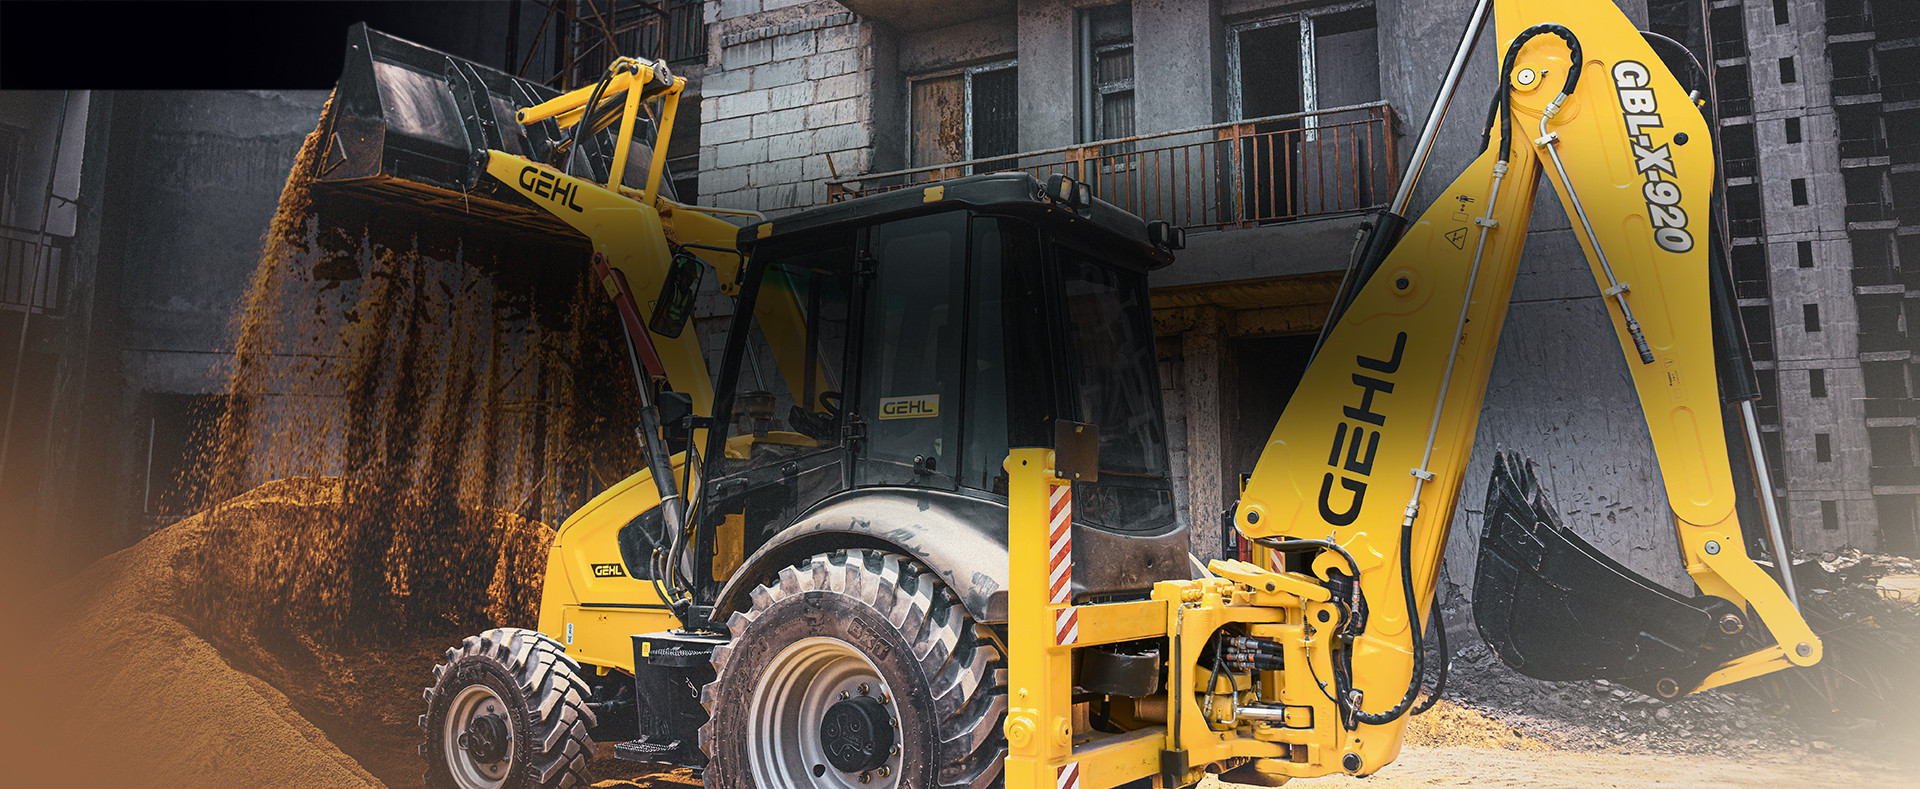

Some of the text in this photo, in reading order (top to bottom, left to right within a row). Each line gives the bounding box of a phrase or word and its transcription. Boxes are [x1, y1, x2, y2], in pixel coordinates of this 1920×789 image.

[1611, 59, 1694, 254] GBL-X-920
[518, 165, 584, 213] GEHL
[883, 399, 933, 415] GEHL
[1318, 331, 1408, 527] GEHL
[594, 565, 623, 576] GEHL
